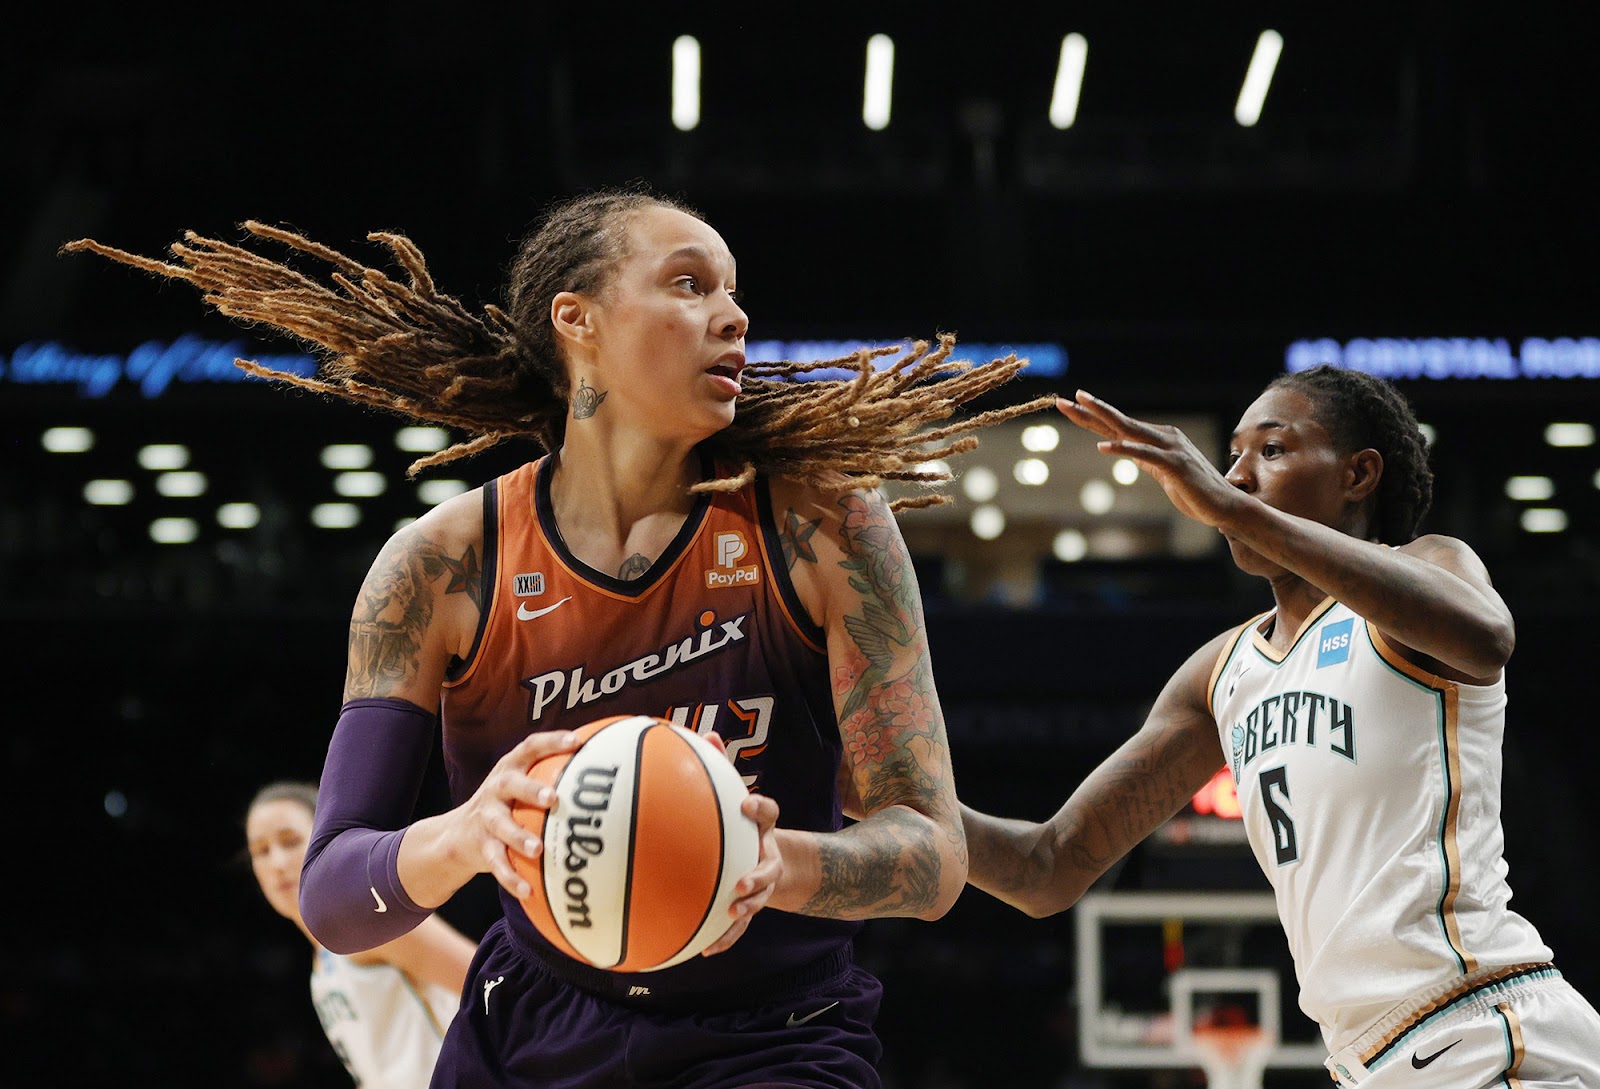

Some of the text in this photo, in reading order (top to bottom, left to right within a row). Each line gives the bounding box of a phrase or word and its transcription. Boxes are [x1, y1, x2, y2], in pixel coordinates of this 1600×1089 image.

[708, 567, 757, 585] PayPal
[529, 610, 746, 721] Phoenix
[1321, 632, 1349, 654] HSS
[563, 763, 621, 930] Wilson
[1259, 764, 1299, 867] 6
